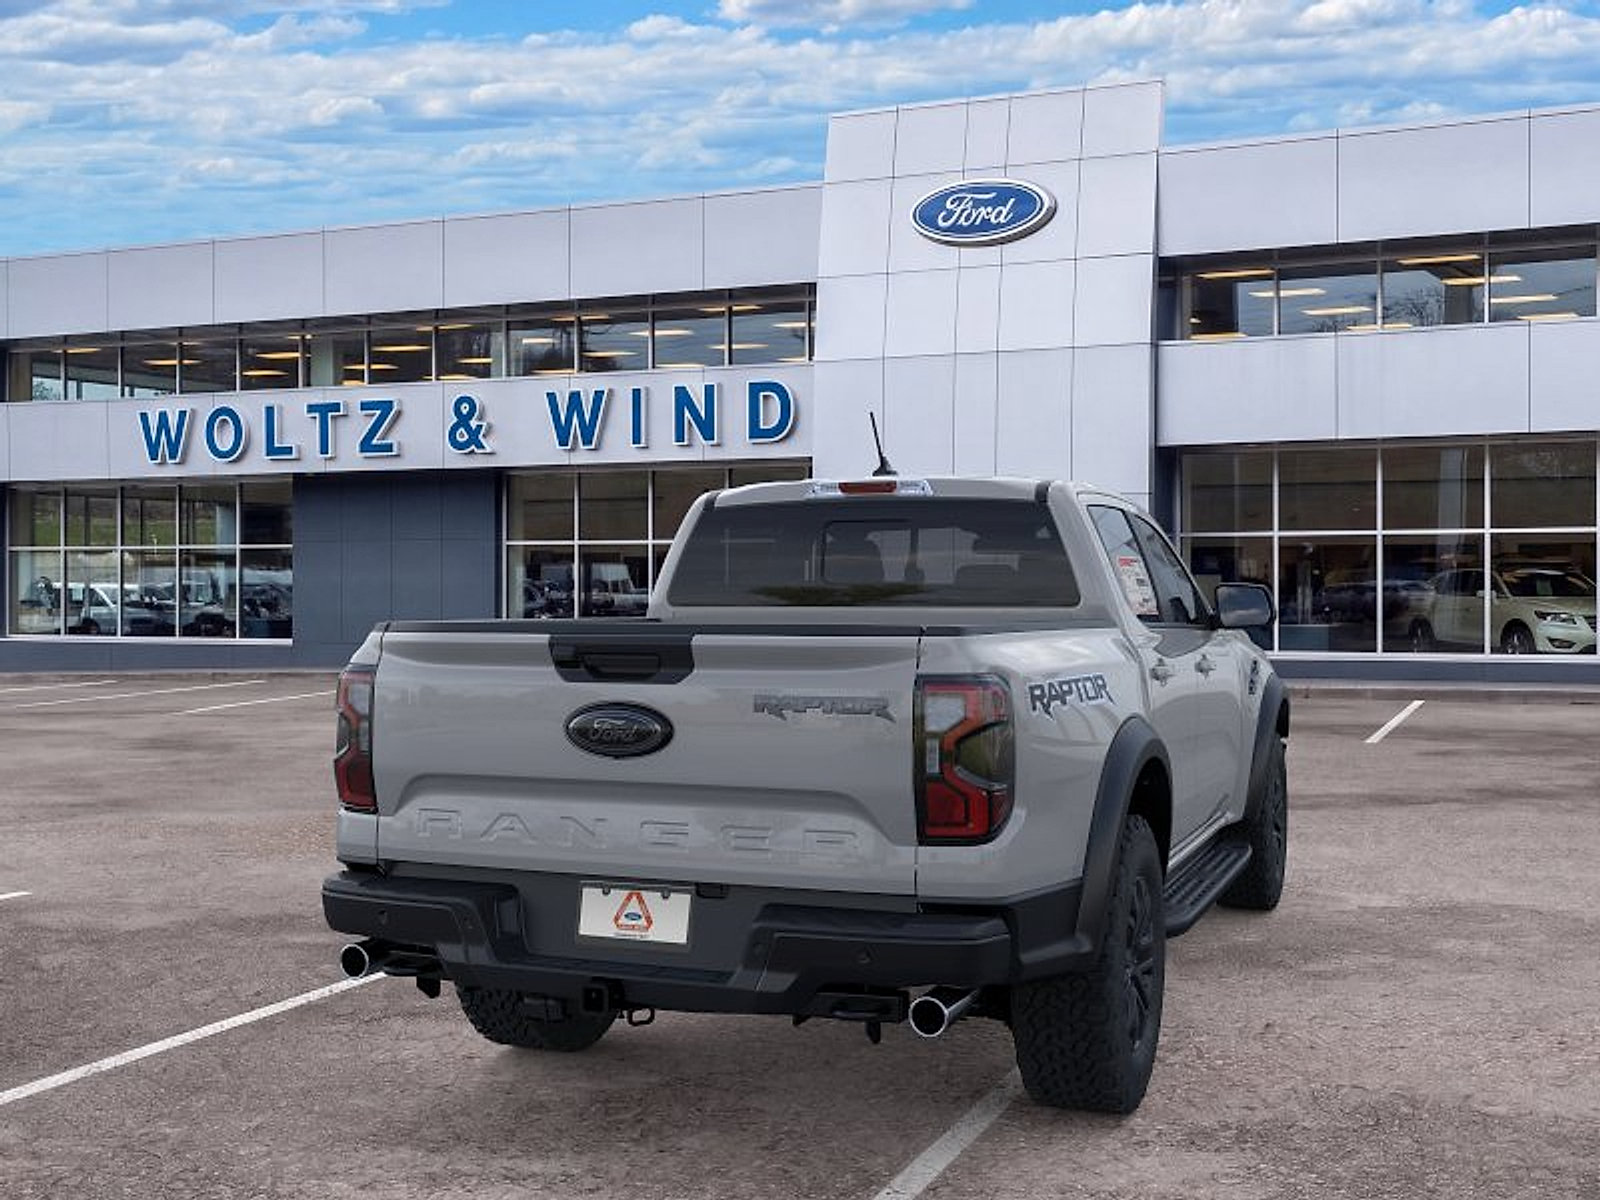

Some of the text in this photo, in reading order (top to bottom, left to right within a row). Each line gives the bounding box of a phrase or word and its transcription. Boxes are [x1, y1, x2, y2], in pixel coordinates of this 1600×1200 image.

[937, 191, 1015, 228] Ford
[137, 380, 797, 465] WOLTZ & WIND
[1028, 672, 1114, 719] RAPTOR
[415, 807, 862, 864] RANGER
